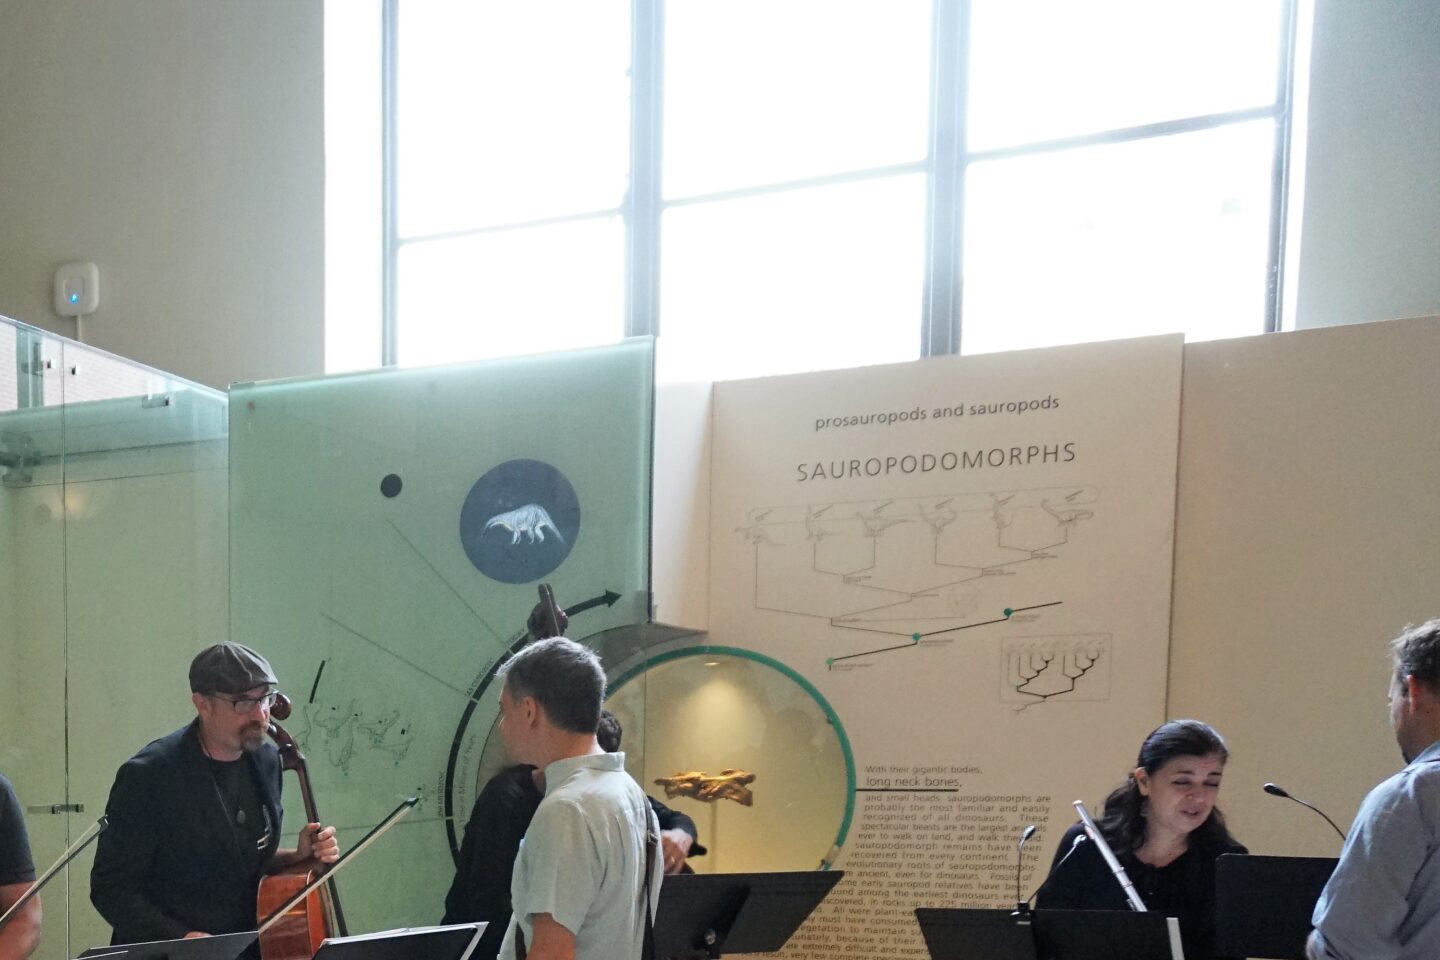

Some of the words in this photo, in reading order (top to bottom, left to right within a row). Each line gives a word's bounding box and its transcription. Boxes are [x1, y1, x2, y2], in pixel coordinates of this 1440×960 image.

[815, 406, 927, 432] prosauropods
[933, 403, 964, 419] and
[970, 395, 1060, 415] sauropods
[796, 442, 1077, 482] SAUROPODOMORPHS
[864, 766, 886, 774] With
[890, 766, 910, 774] their
[912, 766, 946, 776] gigantic
[866, 776, 890, 788] long
[894, 776, 920, 786] neck
[865, 794, 882, 802] and
[886, 794, 910, 802] small
[946, 795, 1032, 804] sauropodomorphs
[864, 804, 906, 813] probably
[958, 804, 996, 812] familiar
[999, 804, 1018, 812] and
[1022, 805, 1050, 814] easily
[863, 813, 918, 823] recognized
[922, 813, 934, 821] of
[938, 814, 950, 822] all
[1019, 814, 1050, 822] These
[860, 823, 910, 833] spectacular
[912, 823, 942, 831] beasts
[960, 823, 976, 831] the
[978, 823, 1008, 833] largest
[880, 832, 890, 840] to
[892, 832, 912, 840] walk
[854, 842, 938, 852] sauropodomorph
[942, 842, 982, 850] remains
[987, 843, 1012, 851] have
[850, 851, 898, 859] recovered
[902, 851, 926, 859] from
[929, 853, 956, 862] every
[1020, 853, 1040, 861] The
[846, 861, 904, 870] evolutionary
[907, 861, 932, 869] roots
[920, 870, 933, 878] for
[990, 872, 1020, 880] Fossils
[1022, 872, 1032, 880] of
[861, 879, 883, 889] early
[887, 880, 931, 890] sauropod
[934, 881, 973, 889] relatives
[1004, 882, 1028, 890] been
[830, 888, 854, 896] ound
[857, 890, 890, 899] among
[894, 889, 908, 897] the
[912, 890, 949, 898] earliest
[952, 891, 1000, 899] dinosaurs
[822, 898, 866, 907] iscovered,
[910, 901, 922, 909] up
[960, 900, 992, 908] million
[800, 926, 846, 935] egetation
[802, 944, 842, 953] extremely
